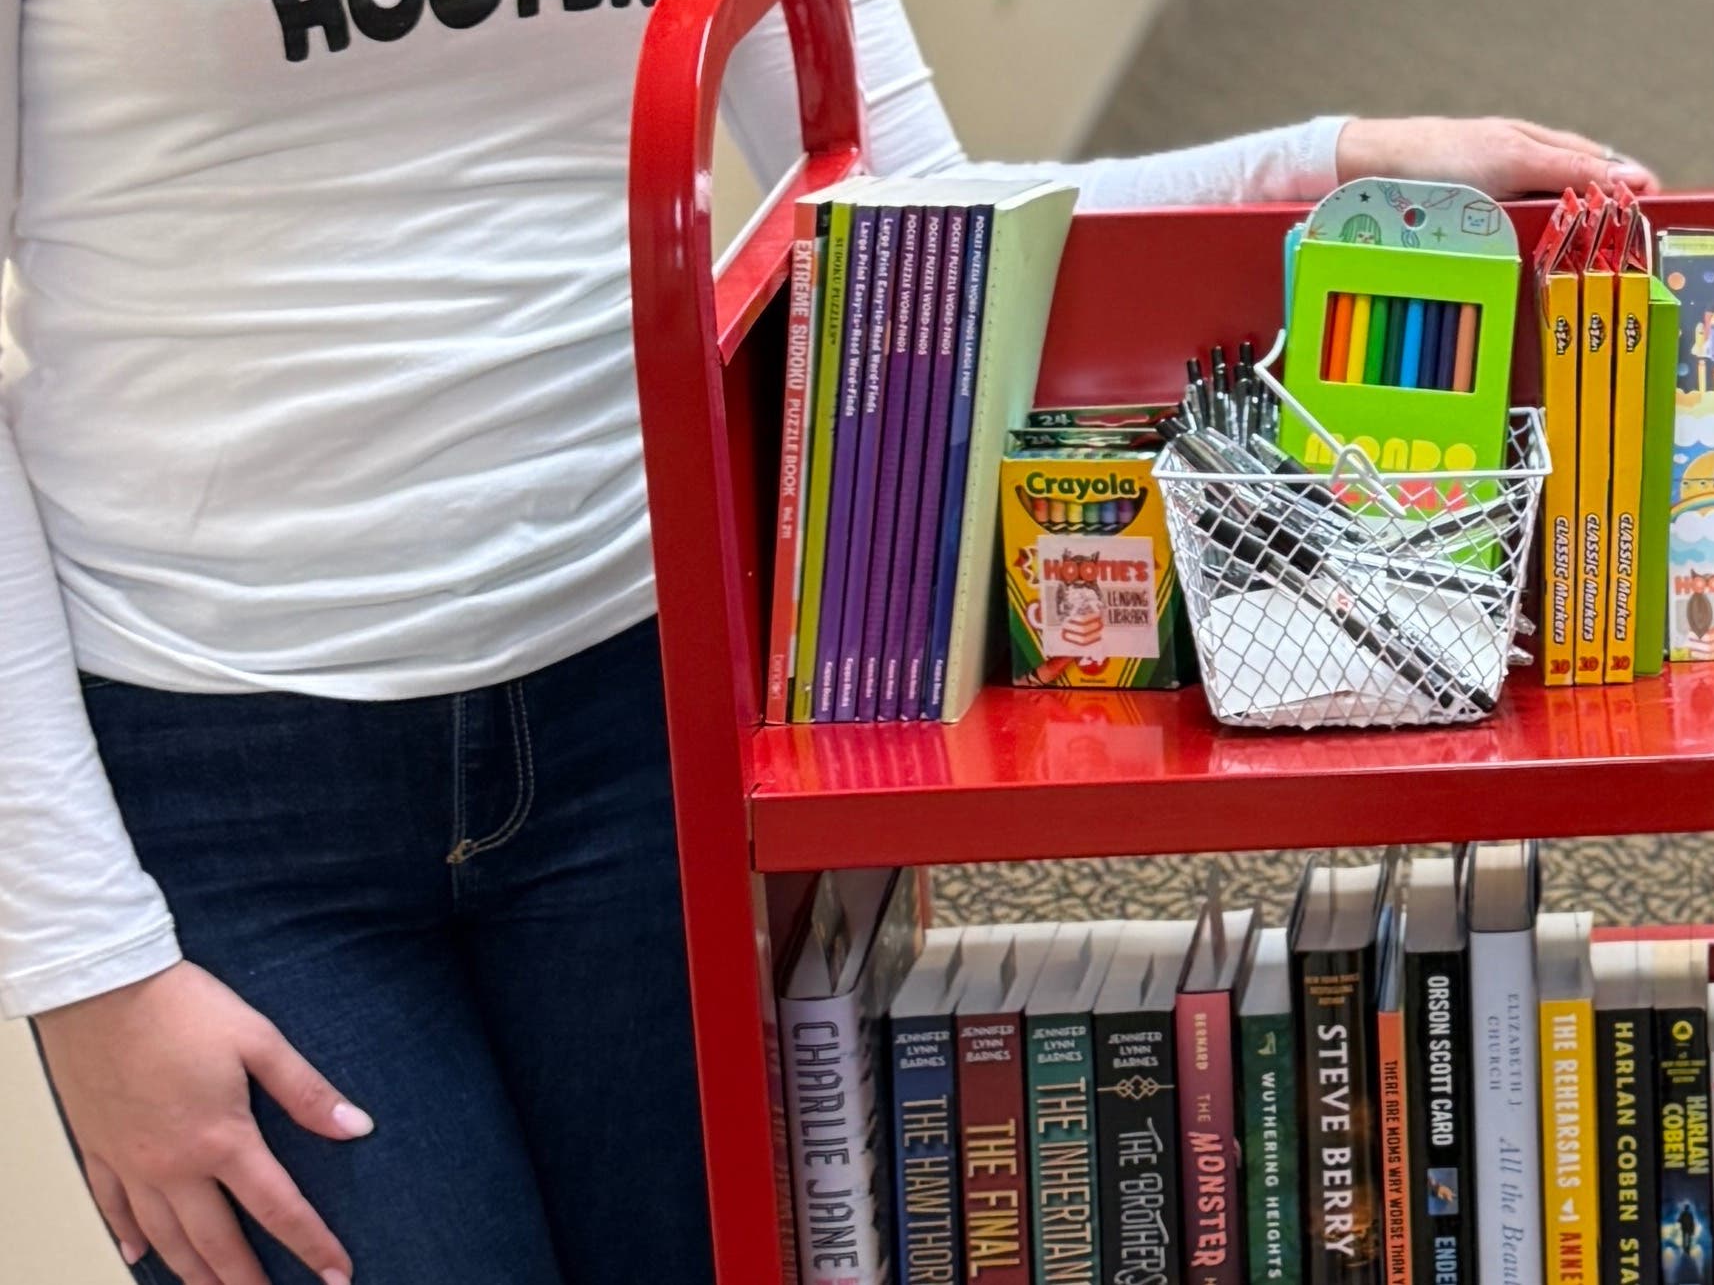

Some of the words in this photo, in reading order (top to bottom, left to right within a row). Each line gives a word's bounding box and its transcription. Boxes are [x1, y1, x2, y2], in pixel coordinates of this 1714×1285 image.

[858, 222, 871, 251] Large
[905, 214, 918, 250] POCKET
[973, 215, 985, 249] POCKET
[792, 241, 813, 317] EXTREME
[856, 254, 869, 281] Print
[902, 253, 914, 288] PUZZLE
[970, 251, 982, 282] PUZZLE
[786, 324, 809, 389] SUDOKU
[785, 398, 801, 455] PUZZLE
[782, 458, 798, 496] BOOK
[1026, 472, 1137, 501] Crayola
[1043, 558, 1149, 582] HOOTIE'S
[1555, 516, 1569, 580] CLASSIC
[1107, 590, 1149, 607] LENDING
[1108, 608, 1150, 625] LIBRARY
[1554, 581, 1569, 645] Markers
[1427, 976, 1450, 1035] ORSON
[894, 1031, 950, 1045] JENNIFER
[907, 1044, 938, 1056] LYNN
[1487, 1016, 1502, 1091] CHURCH
[1507, 993, 1522, 1092] ELIZABETH
[1553, 1014, 1577, 1051] THE
[1317, 1024, 1350, 1133] STEVE
[1384, 1060, 1399, 1095] THERE
[1429, 1040, 1452, 1094] SCOTT
[1614, 1022, 1636, 1126] HARLAN
[792, 1021, 850, 1167] CHARLIE
[902, 1094, 948, 1147] THE
[1036, 1077, 1088, 1133] THE
[1197, 1094, 1211, 1122] THE
[1386, 1100, 1400, 1123] ARE
[965, 1118, 1017, 1178] THE
[1261, 1072, 1280, 1187] WUTHERING
[1387, 1127, 1401, 1165] MOMS
[1431, 1099, 1453, 1146] CARD
[1554, 1060, 1581, 1188] REHEARSALS
[1662, 1103, 1685, 1169] COBEN
[1686, 1096, 1709, 1174] HARLAN
[1499, 1137, 1523, 1174] All
[1617, 1135, 1638, 1222] COBEN
[806, 1179, 859, 1270] JANE
[1188, 1131, 1228, 1266] MONSTER
[1322, 1147, 1355, 1257] BERRY
[1388, 1199, 1403, 1240] WORSE
[1501, 1183, 1523, 1214] the
[968, 1190, 1020, 1277] FINAL
[1266, 1196, 1282, 1279] HEIGHTS
[1389, 1244, 1405, 1274] THAN
